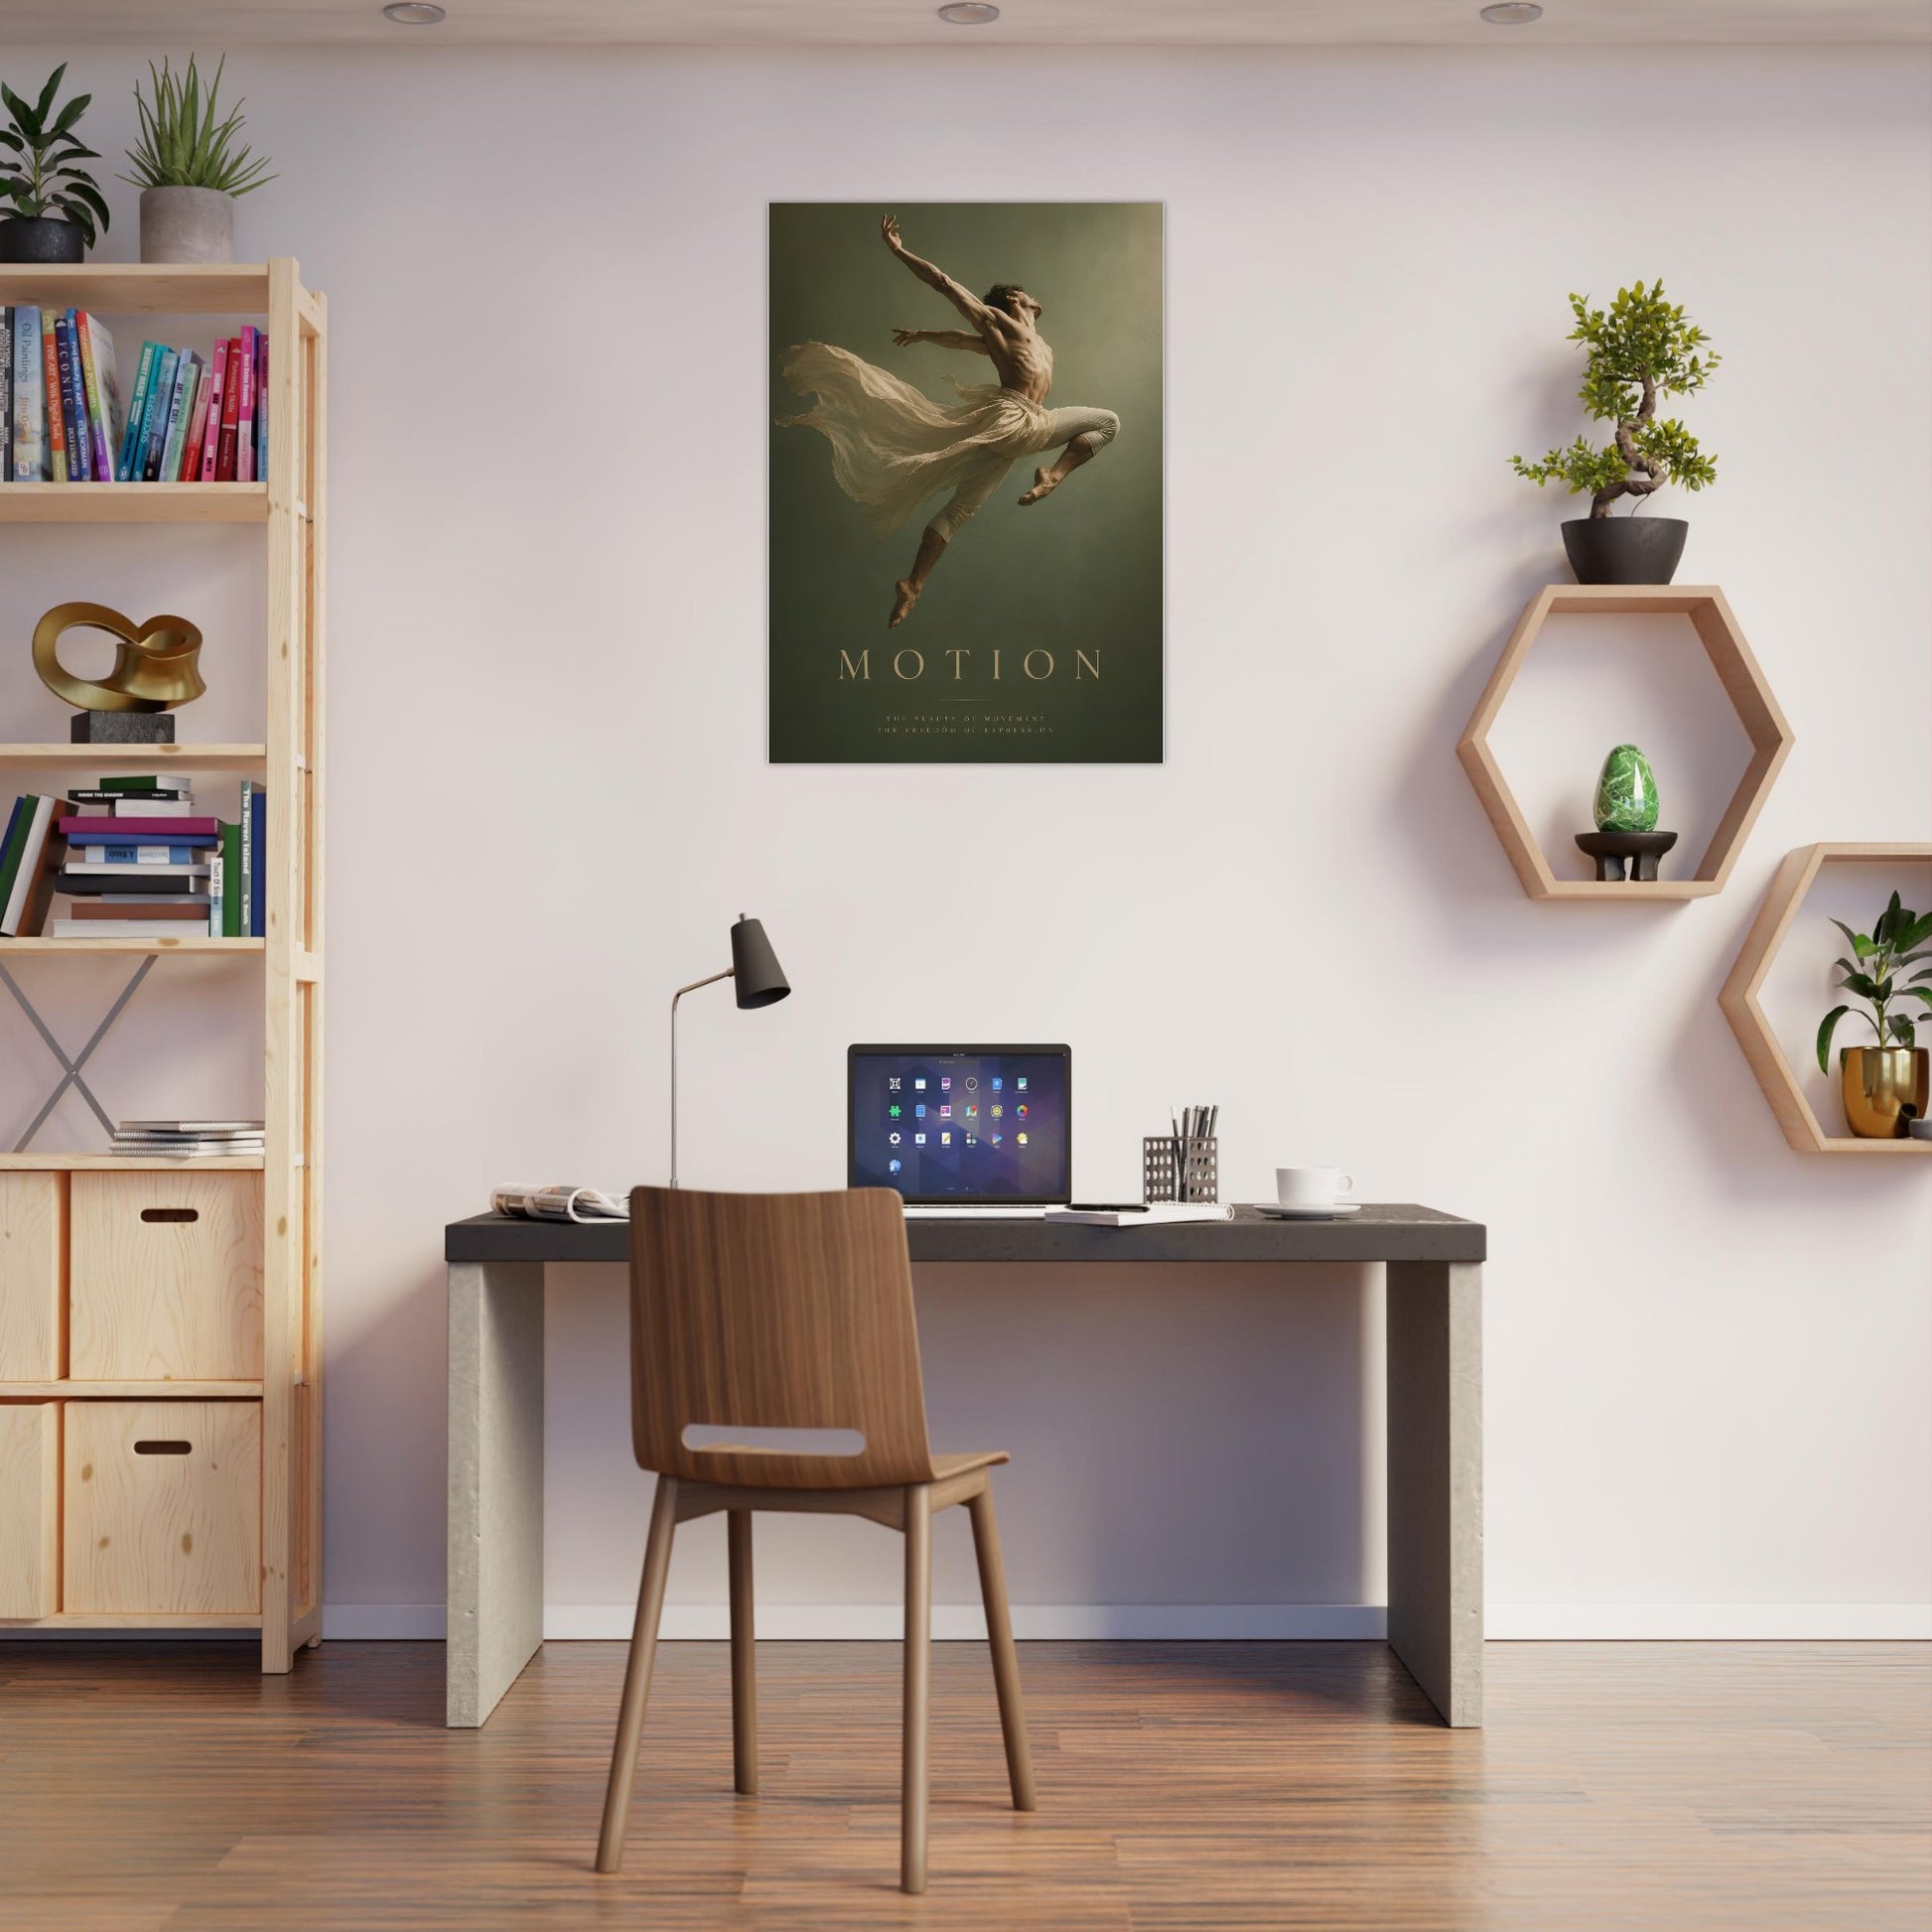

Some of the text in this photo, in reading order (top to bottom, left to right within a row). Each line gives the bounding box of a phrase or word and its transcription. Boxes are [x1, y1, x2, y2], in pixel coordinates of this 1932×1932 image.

[19, 322, 32, 384] Oil Paintings
[71, 356, 80, 381] Beauty
[79, 324, 96, 410] Watercolor Portraits
[59, 342, 72, 405] ICONIC
[175, 382, 184, 394] ART
[227, 360, 239, 414] Parenting Skills
[50, 399, 60, 422] Digital
[79, 437, 89, 469] NORMAN
[838, 649, 1101, 680] MOTION
